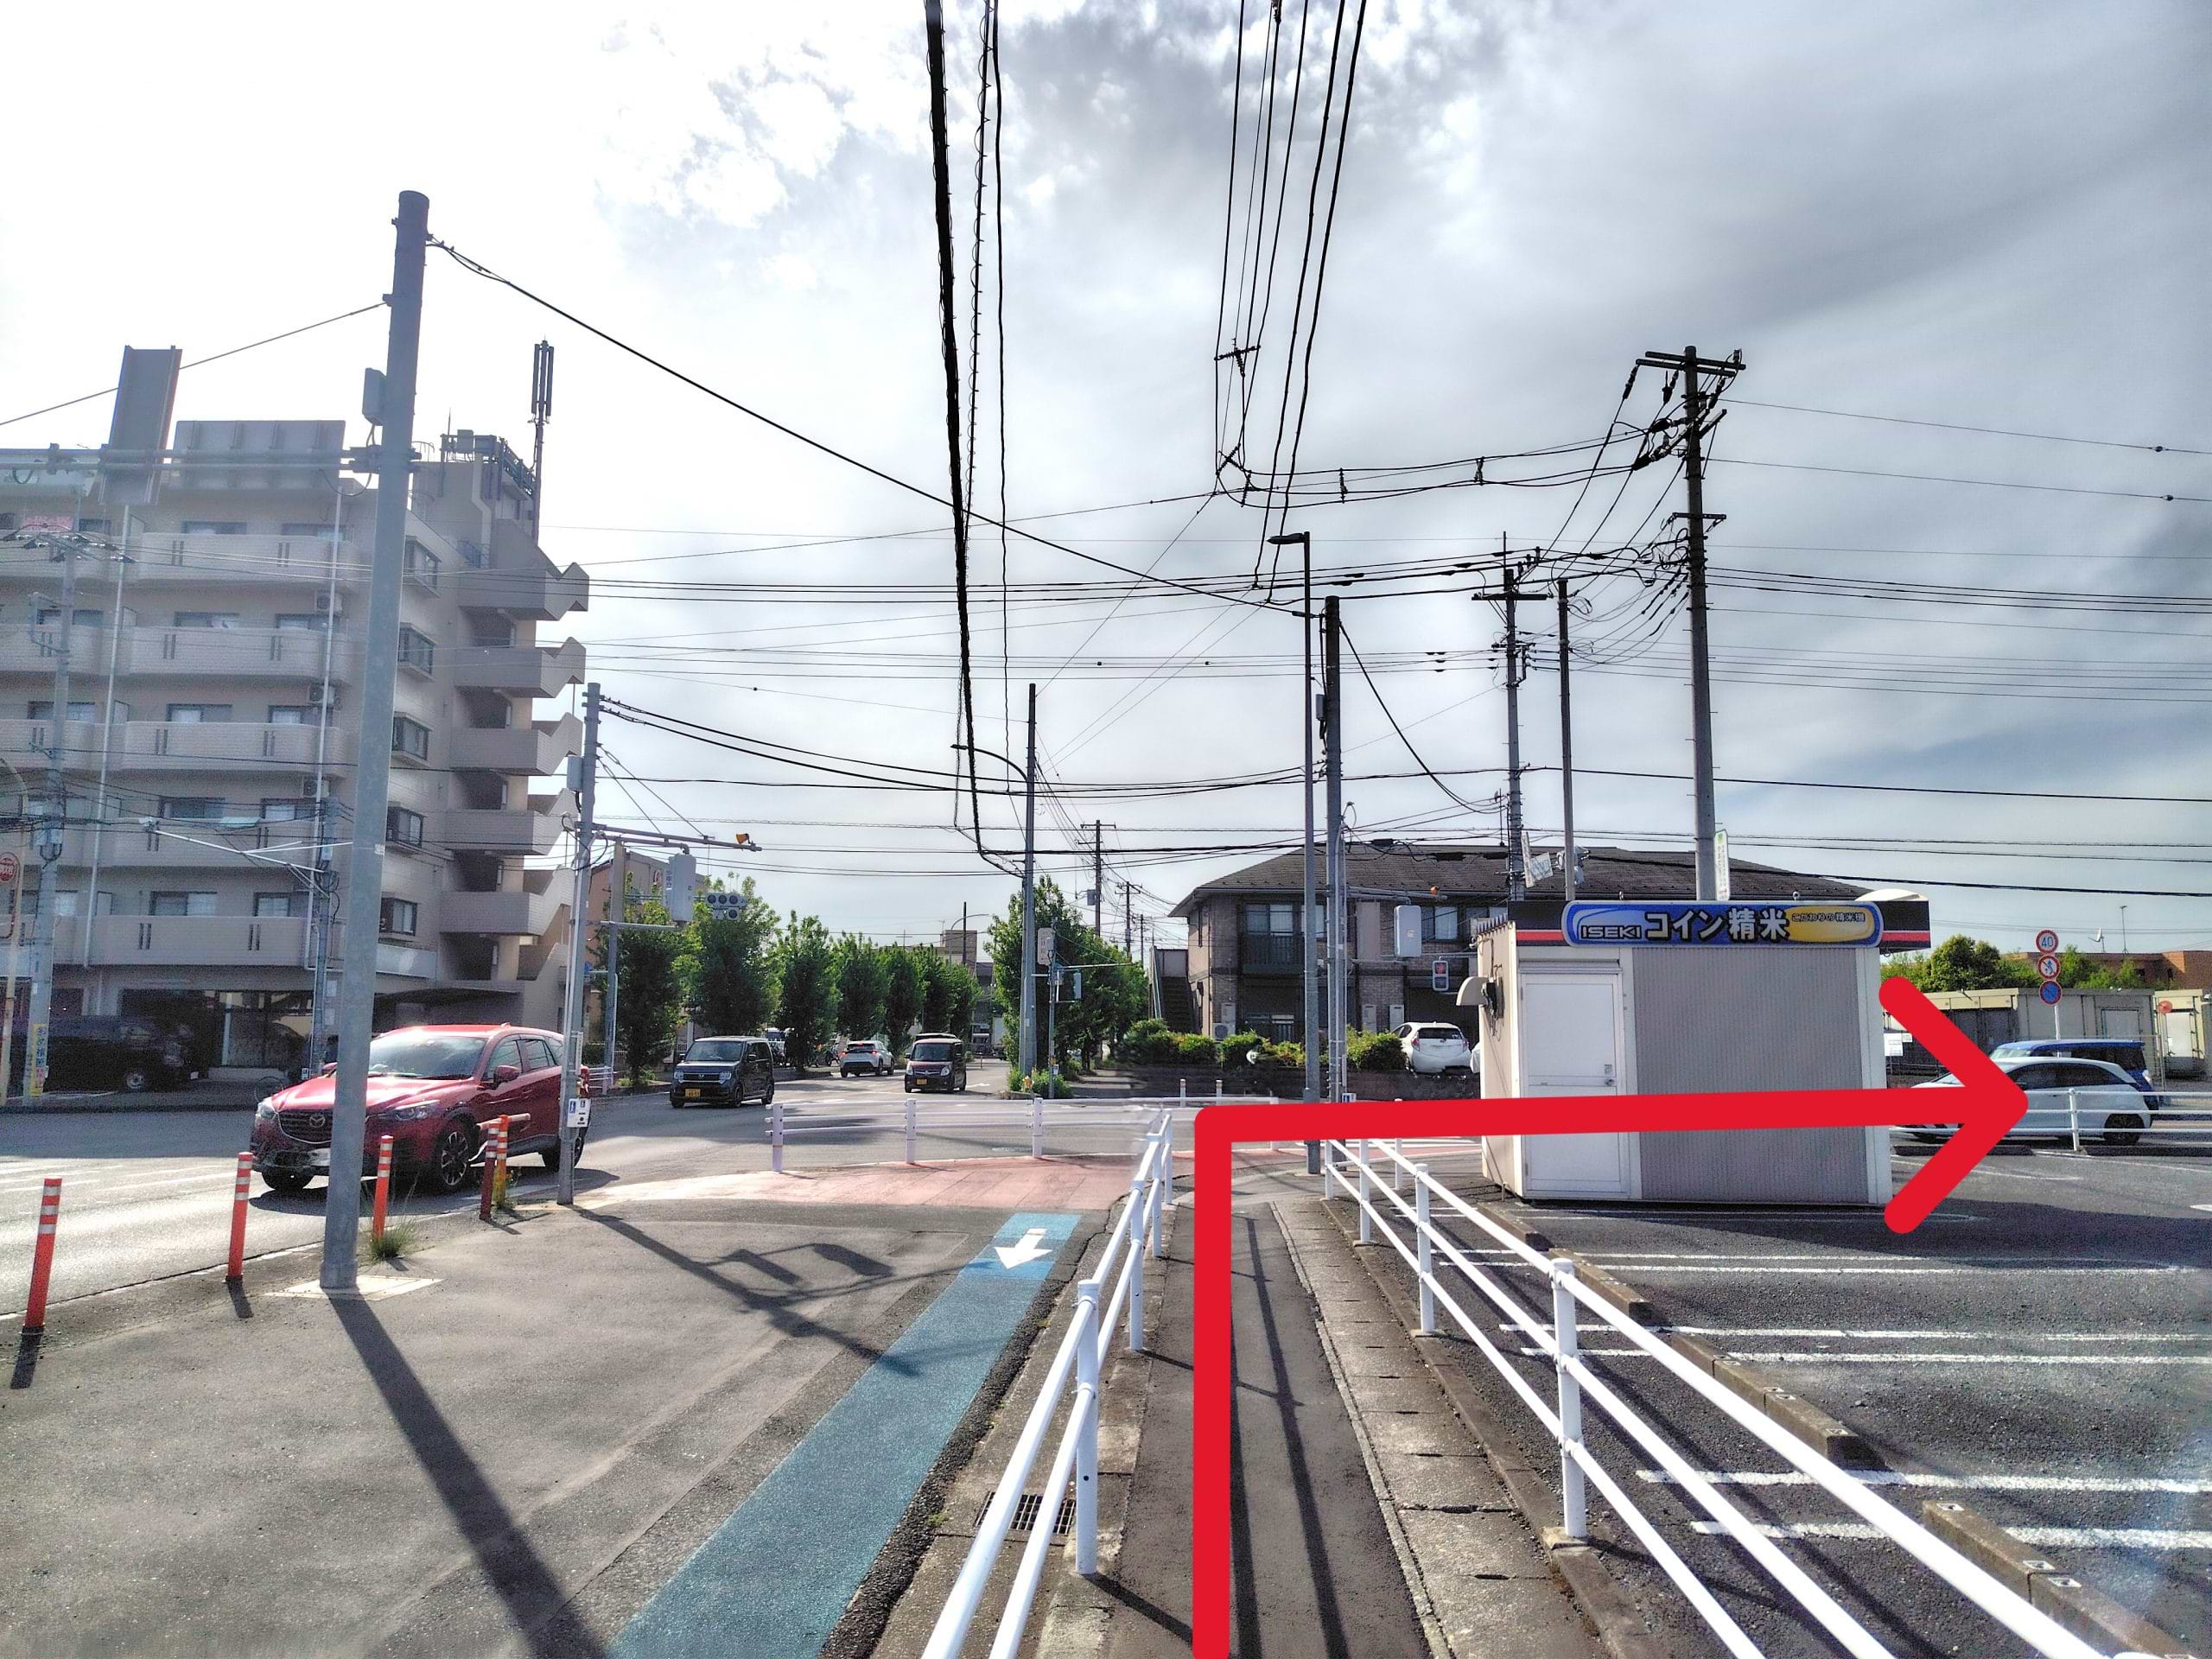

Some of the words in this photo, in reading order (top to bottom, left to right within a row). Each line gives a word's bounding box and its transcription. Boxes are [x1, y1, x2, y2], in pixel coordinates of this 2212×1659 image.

[1646, 907, 1789, 941] コイン精米
[1581, 925, 1642, 938] ISEKI
[2041, 936, 2054, 947] 40
